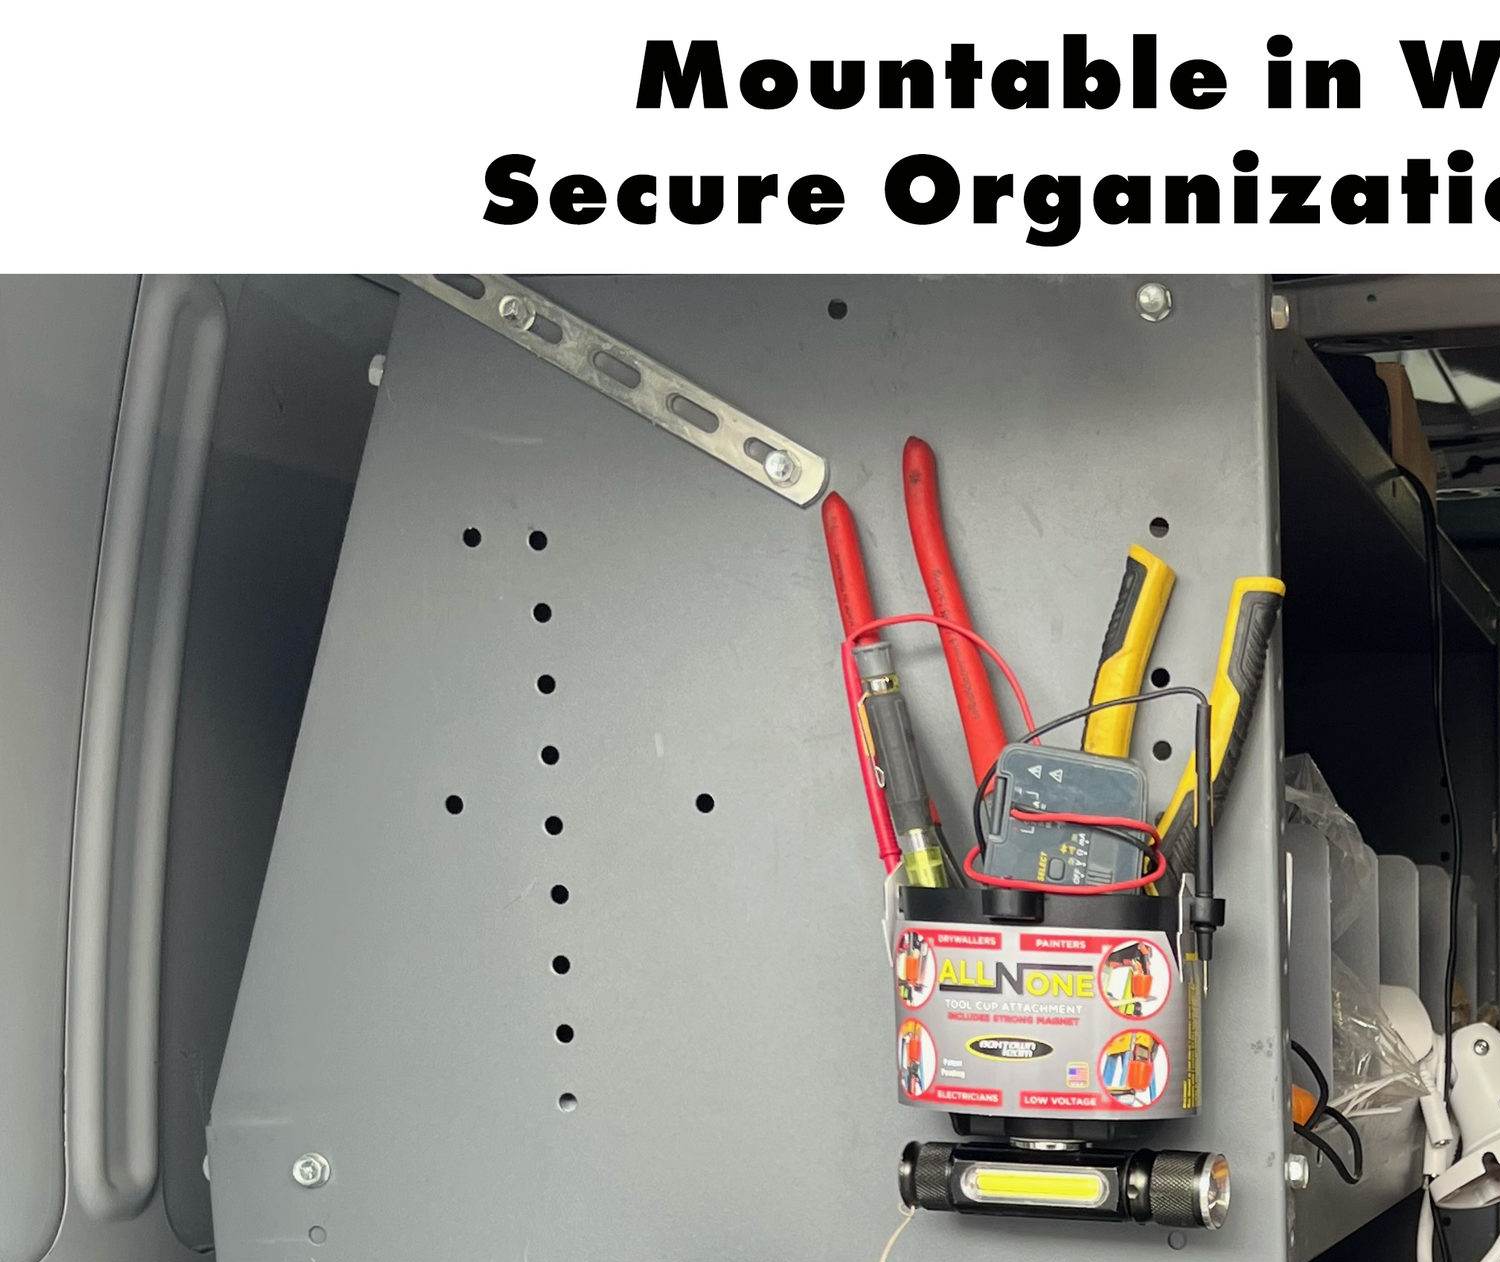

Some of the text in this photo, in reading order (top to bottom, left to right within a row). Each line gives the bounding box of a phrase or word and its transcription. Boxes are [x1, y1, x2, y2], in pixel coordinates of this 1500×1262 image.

[1037, 851, 1048, 882] SELECT
[938, 934, 997, 947] DRYWALLERS
[1035, 938, 1087, 950] PAINTERS
[945, 999, 1083, 1015] TOOL CUP ATTACHMENT
[937, 1091, 999, 1104] ELECTRICIANS
[1024, 1096, 1097, 1107] LOW VOLTAGE
